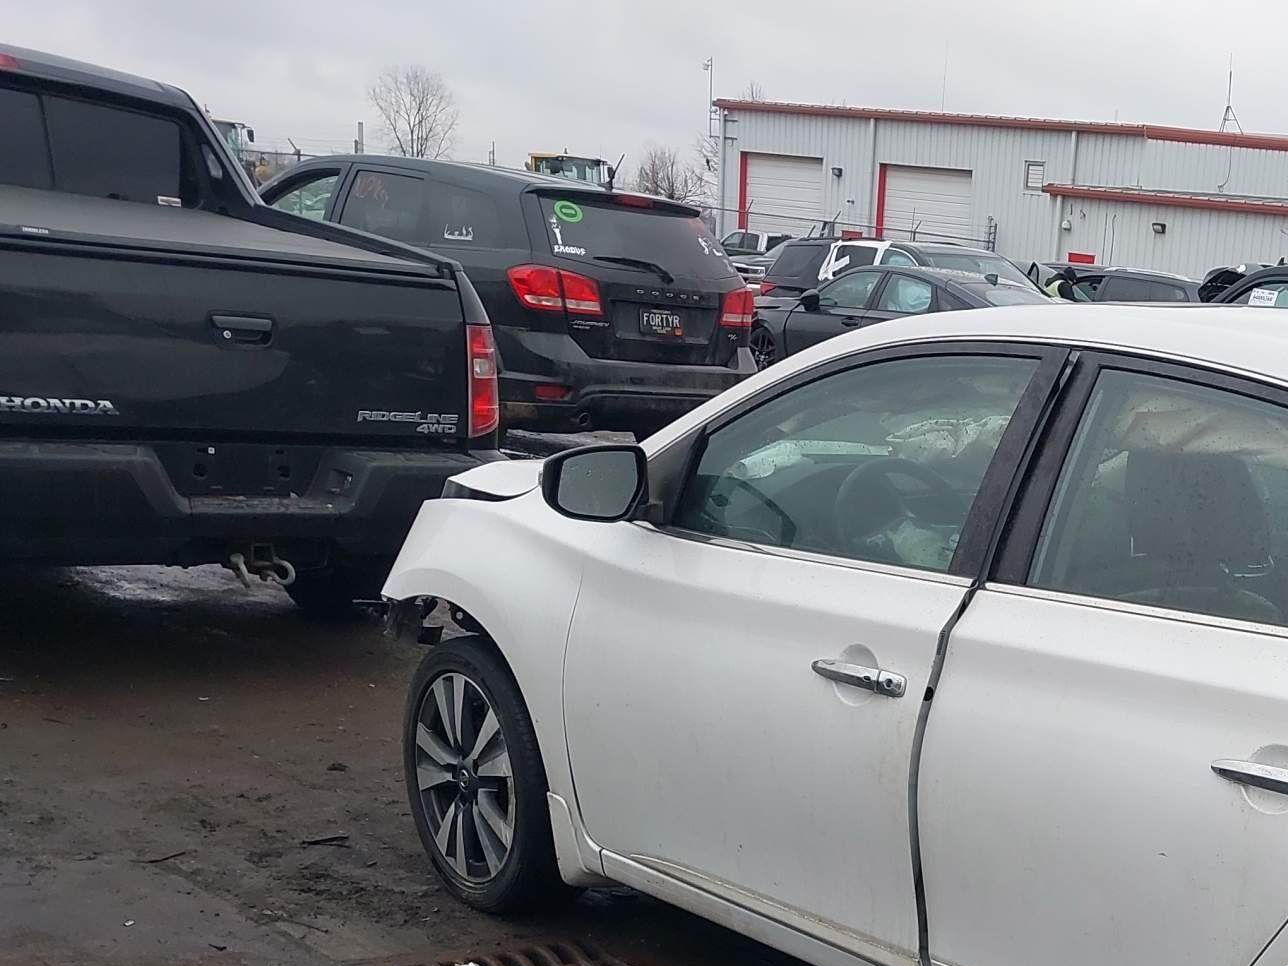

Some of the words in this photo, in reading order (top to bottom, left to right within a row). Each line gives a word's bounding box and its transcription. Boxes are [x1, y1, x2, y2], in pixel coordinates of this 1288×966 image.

[643, 312, 681, 328] FORTYR
[0, 396, 120, 415] HONDA
[357, 410, 459, 424] RIDGELINE
[415, 423, 457, 434] 4WD
